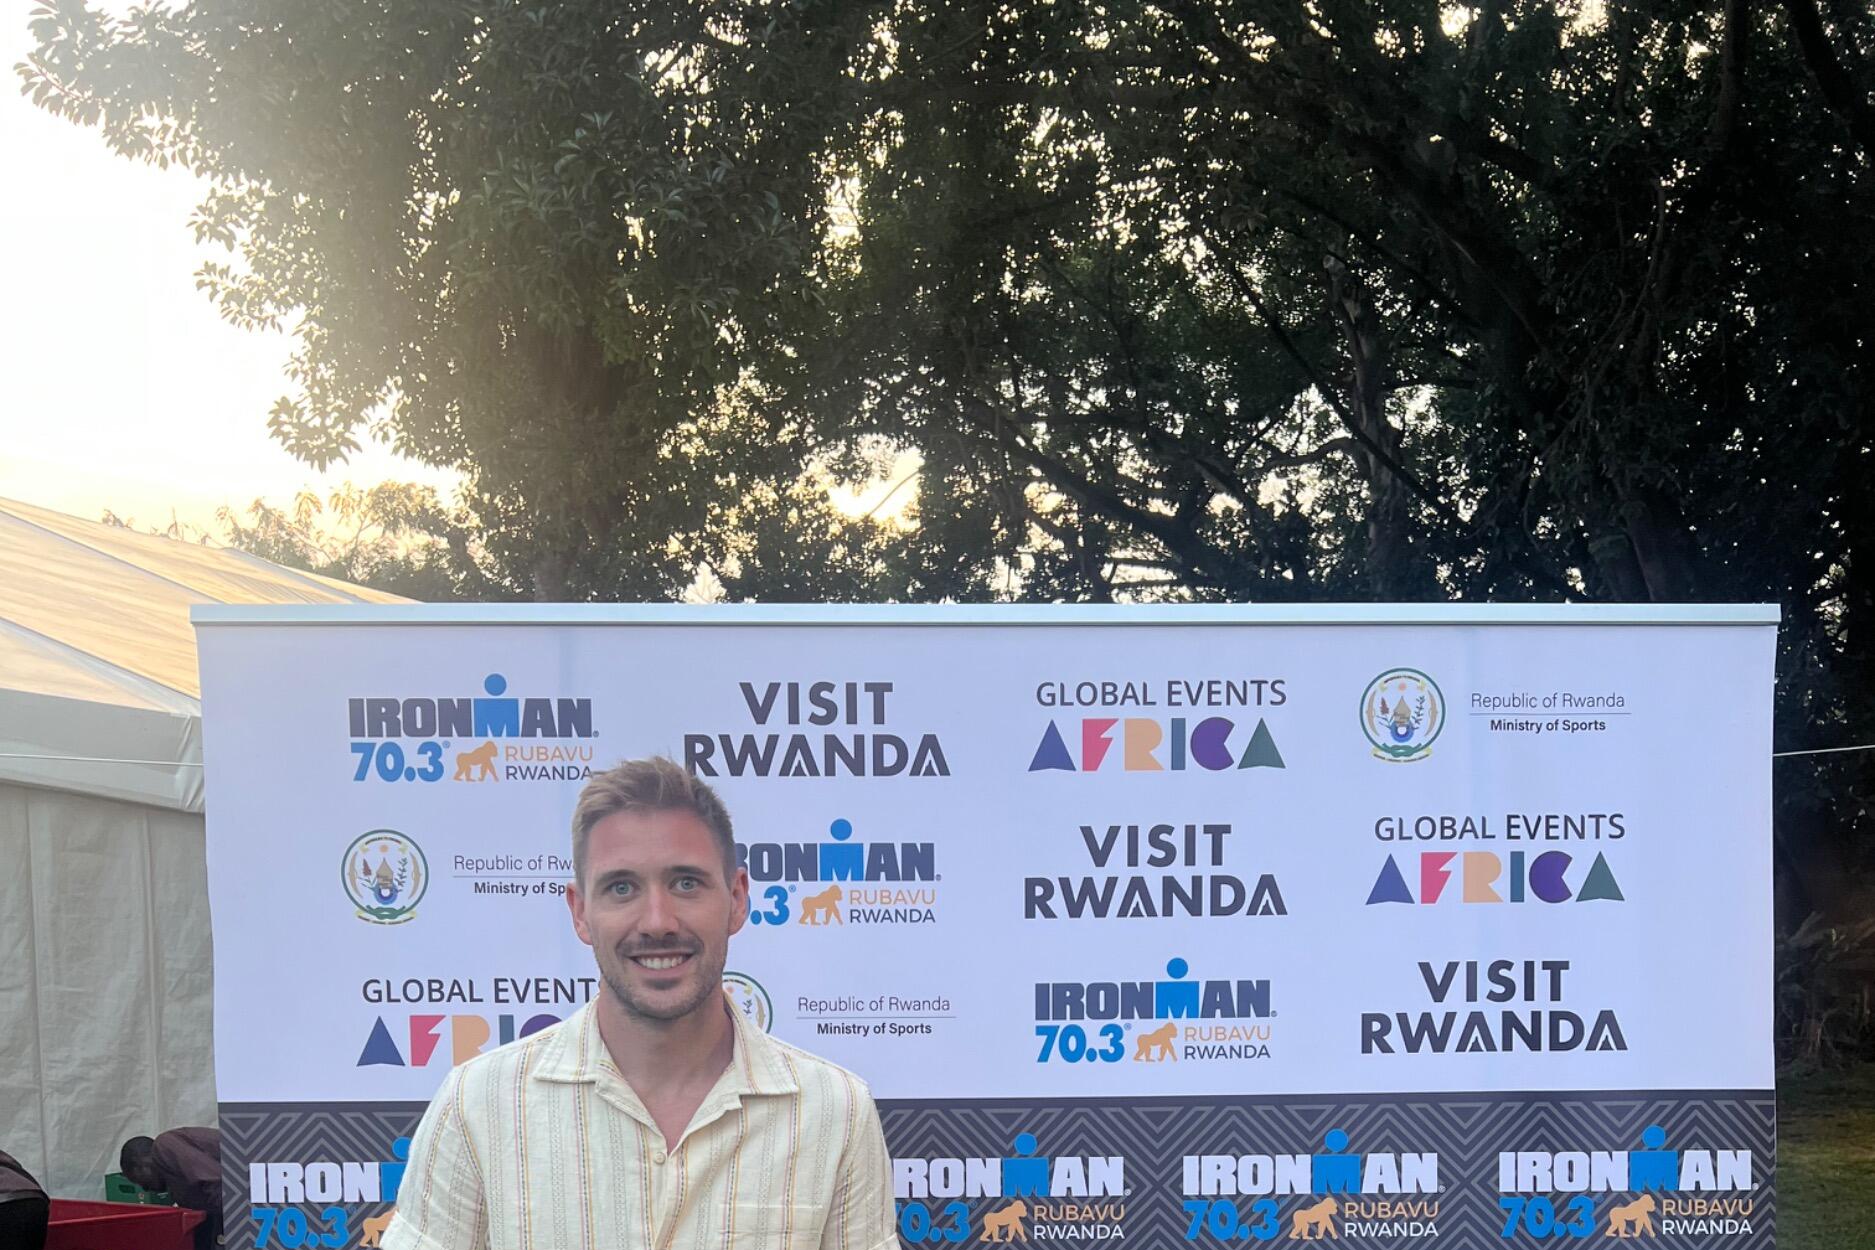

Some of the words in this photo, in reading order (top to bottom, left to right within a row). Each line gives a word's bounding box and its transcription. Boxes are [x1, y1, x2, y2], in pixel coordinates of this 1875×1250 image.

[349, 674, 596, 738] IRONMAN
[739, 682, 893, 725] VISIT
[1037, 682, 1157, 706] GLOBAL
[1168, 680, 1286, 706] EVENTS
[1472, 692, 1537, 711] Republic
[1542, 692, 1558, 708] of
[1563, 692, 1624, 708] Rwanda
[1028, 717, 1286, 772] AFRICA
[1490, 719, 1544, 734] Ministry
[1545, 719, 1559, 731] of
[1562, 719, 1606, 733] Sports
[351, 741, 447, 782] 70.3
[505, 746, 592, 761] RUBAVU
[681, 734, 950, 780] RWANDA
[506, 766, 595, 784] RWANDA
[1080, 824, 1231, 867] VISIT
[1375, 816, 1496, 841] GLOBAL
[1507, 813, 1625, 840] EVENTS
[455, 855, 522, 873] Republic
[527, 855, 543, 872] of
[736, 819, 934, 882] ONMAN
[474, 881, 530, 897] Ministry
[532, 882, 545, 894] of
[848, 890, 936, 905] RUBAVU
[1024, 874, 1288, 920] RWANDA
[1365, 851, 1625, 905] AFRICA
[850, 909, 935, 923] RWANDA
[362, 979, 483, 1003] GLOBAL
[493, 978, 600, 1003] EVENT
[1035, 957, 1273, 1022] IRONMAN
[1418, 960, 1570, 1003] VISIT
[798, 996, 864, 1015] Republic
[869, 996, 884, 1011] of
[889, 995, 950, 1012] Rwanda
[356, 1014, 562, 1067] AFRI
[816, 1023, 870, 1037] Ministry
[873, 1022, 886, 1034] of
[889, 1023, 932, 1037] Sports
[1035, 1023, 1127, 1063] 70.3
[1184, 1026, 1270, 1041] RUBAVU
[1361, 1009, 1628, 1054] RWANDA
[1184, 1045, 1271, 1059] RWANDA
[249, 1137, 410, 1203] IRON
[893, 1133, 1125, 1199] RONMAN
[1183, 1128, 1438, 1195] IRONMAN
[1498, 1125, 1753, 1191] IRONMAN
[251, 1206, 349, 1249] 70.3
[895, 1202, 970, 1243] 0.3
[1033, 1206, 1125, 1222] RUBAVU
[1183, 1199, 1280, 1240] 70.3
[1344, 1203, 1439, 1219] RUBAVU
[1499, 1196, 1596, 1239] 70.3
[1662, 1199, 1753, 1217] RUBAVU
[1662, 1218, 1753, 1235] RWANDA
[1033, 1223, 1125, 1239] RWANDA
[1344, 1220, 1438, 1237] RWANDA
